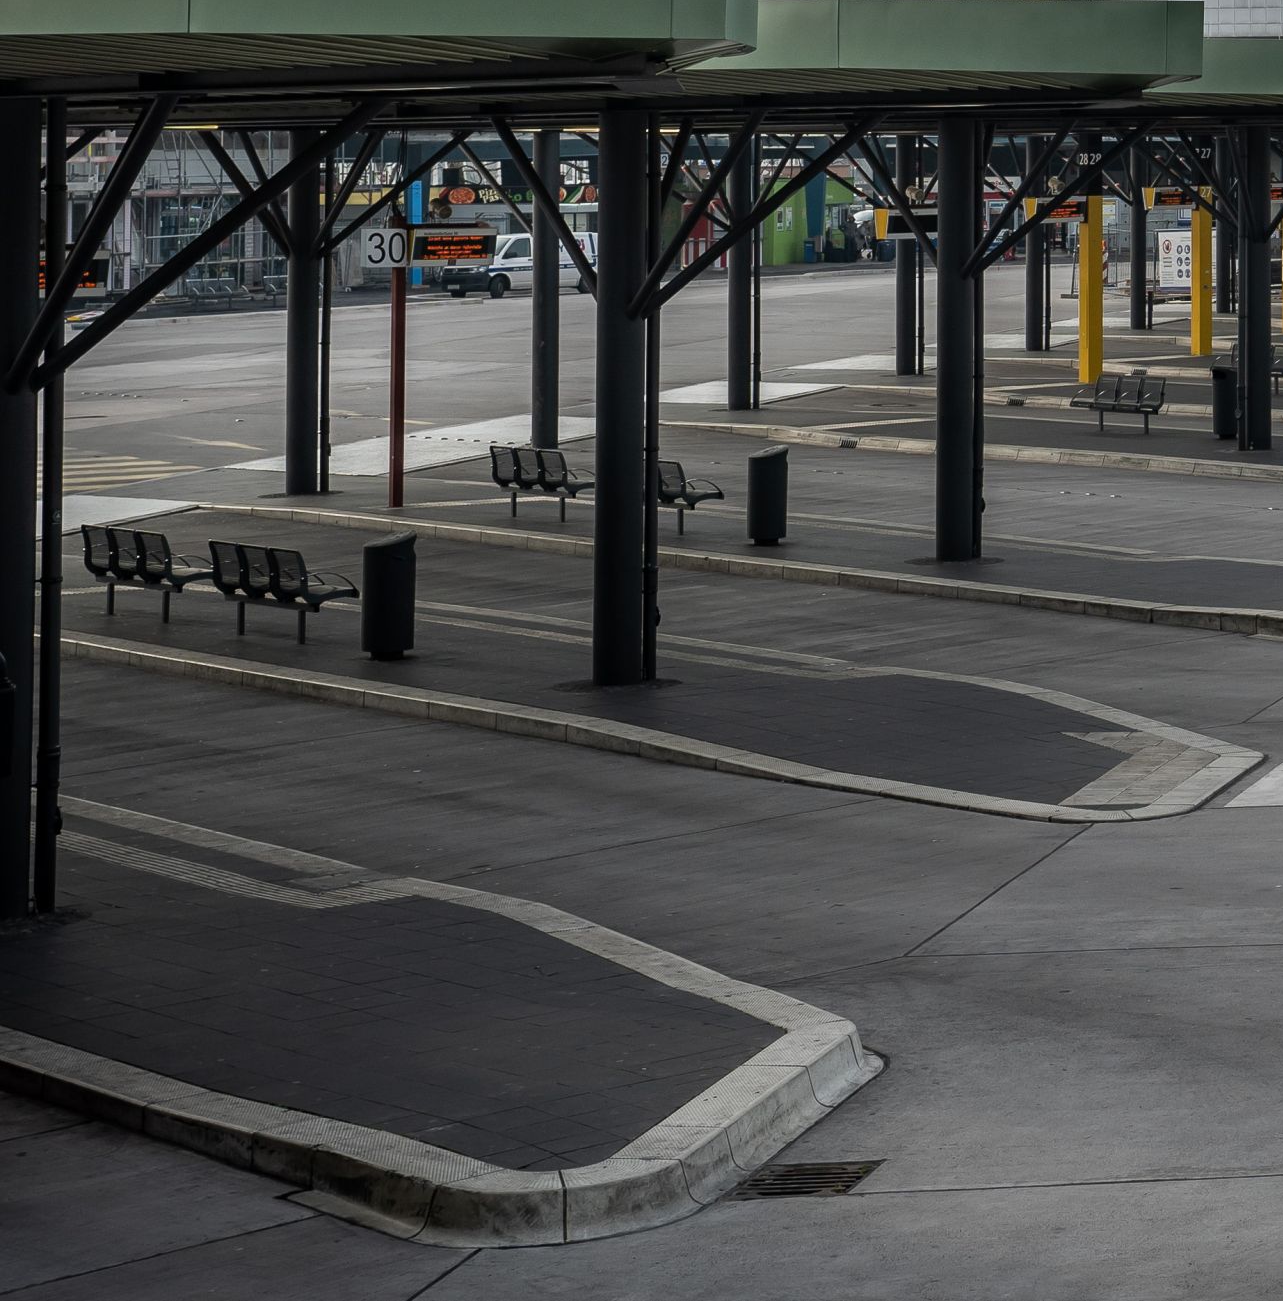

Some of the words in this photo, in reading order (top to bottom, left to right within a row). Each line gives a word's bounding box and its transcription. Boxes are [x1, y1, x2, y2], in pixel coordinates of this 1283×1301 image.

[1201, 148, 1211, 158] 27
[1080, 154, 1089, 165] 28
[1201, 186, 1212, 198] 27
[367, 232, 406, 264] 30
